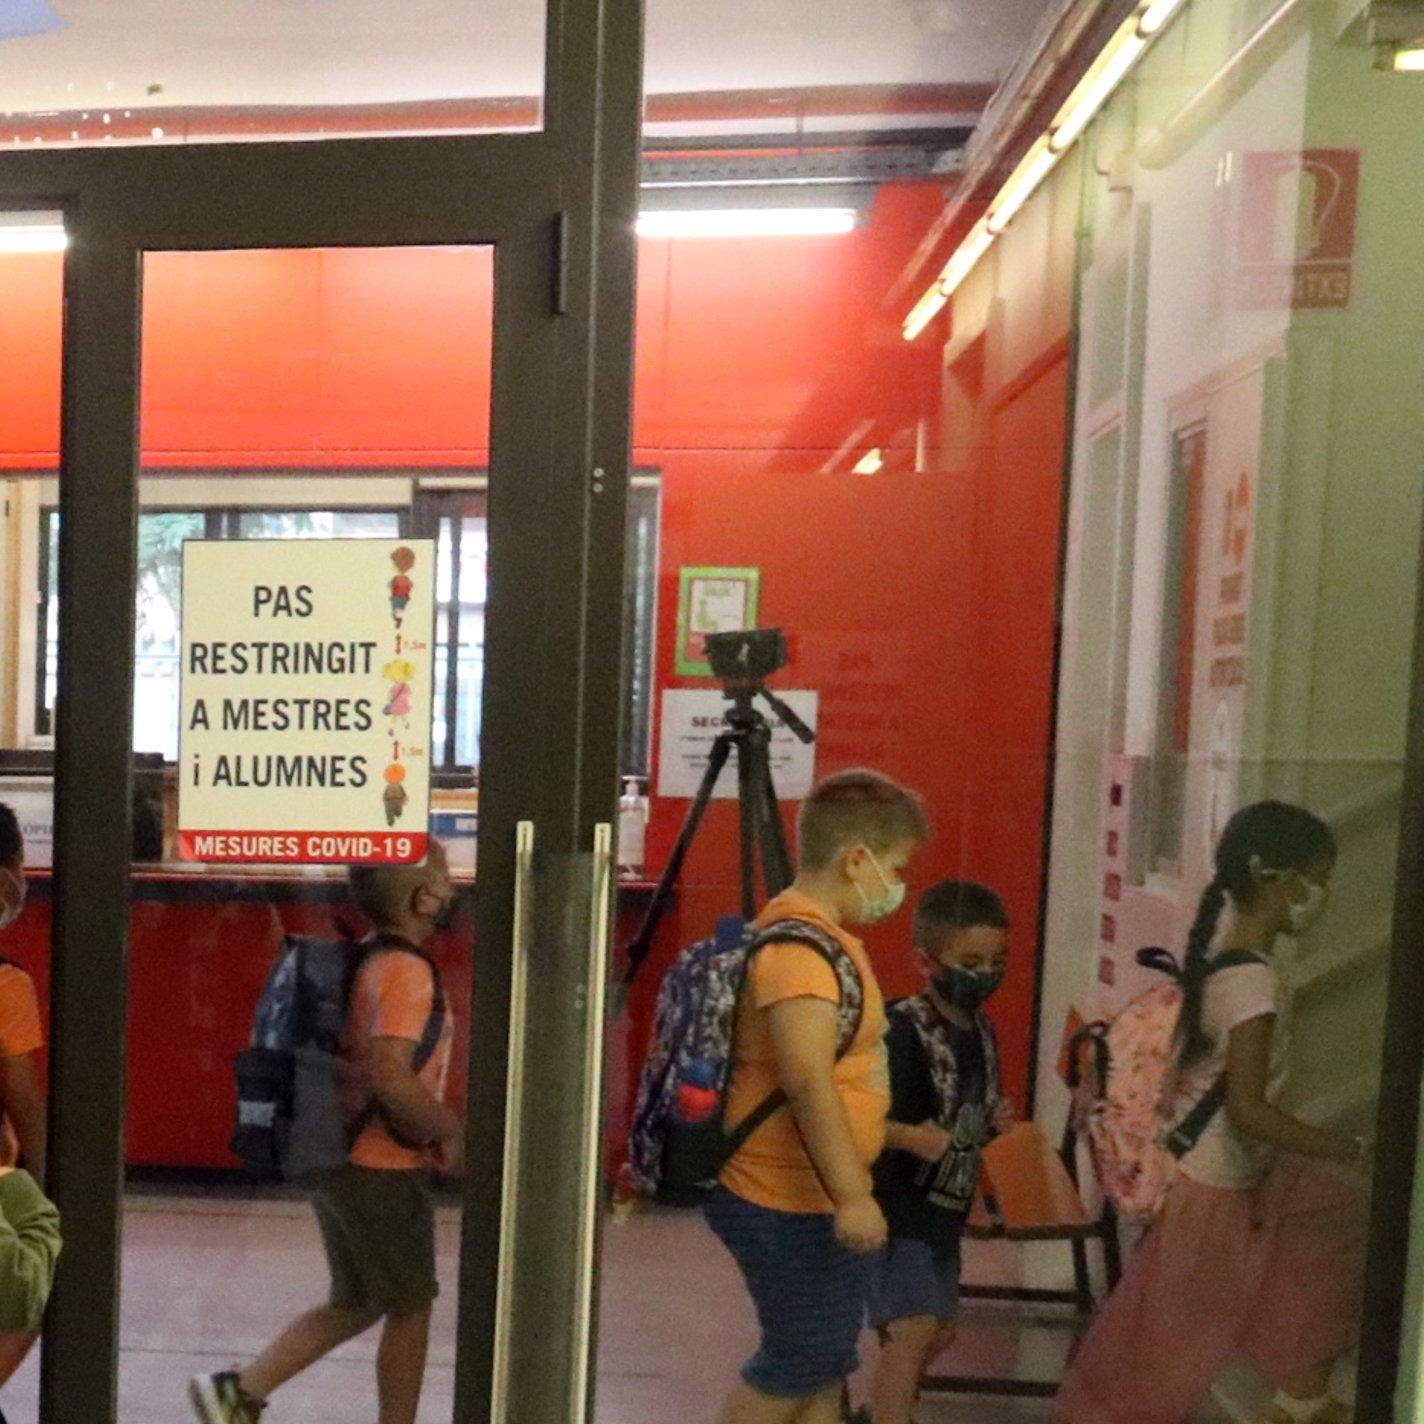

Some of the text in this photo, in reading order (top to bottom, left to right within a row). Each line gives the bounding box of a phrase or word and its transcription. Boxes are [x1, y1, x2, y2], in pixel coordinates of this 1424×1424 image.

[252, 584, 314, 618] PAS
[189, 641, 378, 675] RESTRINGIT
[189, 698, 373, 732] A MESTRES
[192, 753, 368, 788] i ALUMNES
[194, 834, 412, 858] MESURES COVID-19
